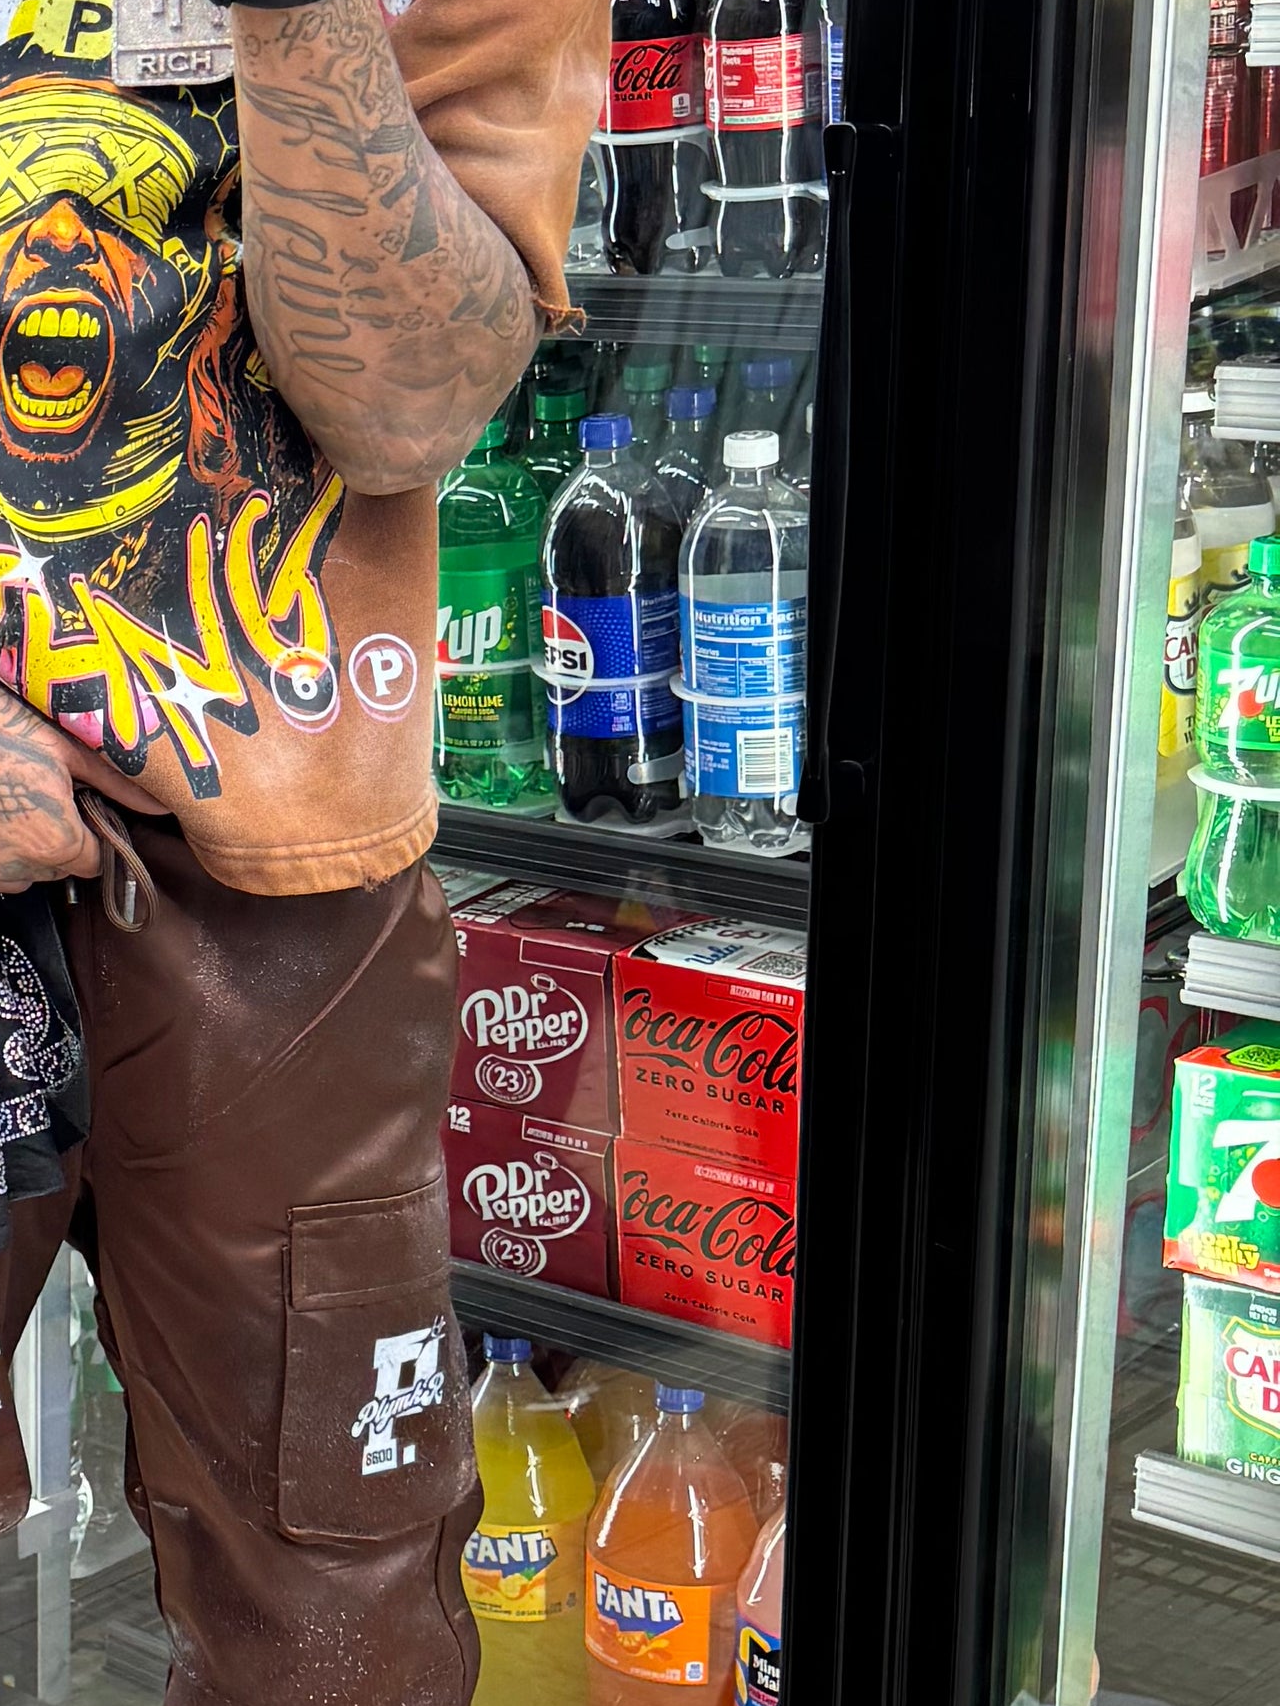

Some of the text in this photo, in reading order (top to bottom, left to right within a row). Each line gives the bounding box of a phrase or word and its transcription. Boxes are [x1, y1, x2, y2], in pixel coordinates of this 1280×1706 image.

[137, 49, 215, 76] RICH
[613, 41, 690, 94] Cola
[694, 611, 762, 626] Nutrition
[294, 674, 316, 703] 6
[367, 650, 403, 695] P
[443, 693, 505, 708] LEMON LIME
[473, 987, 578, 1059] Pepper
[502, 985, 547, 1024] Dr
[492, 1068, 520, 1092] 23
[635, 1068, 787, 1116] ZERO SUGAR
[446, 1105, 472, 1125] 12
[474, 1163, 580, 1231] Pepper
[504, 1161, 550, 1198] Dr
[498, 1239, 527, 1264] 23
[635, 1250, 785, 1305] ZERO SUGAR
[464, 1531, 557, 1566] FANTA
[594, 1573, 683, 1623] FANTA
